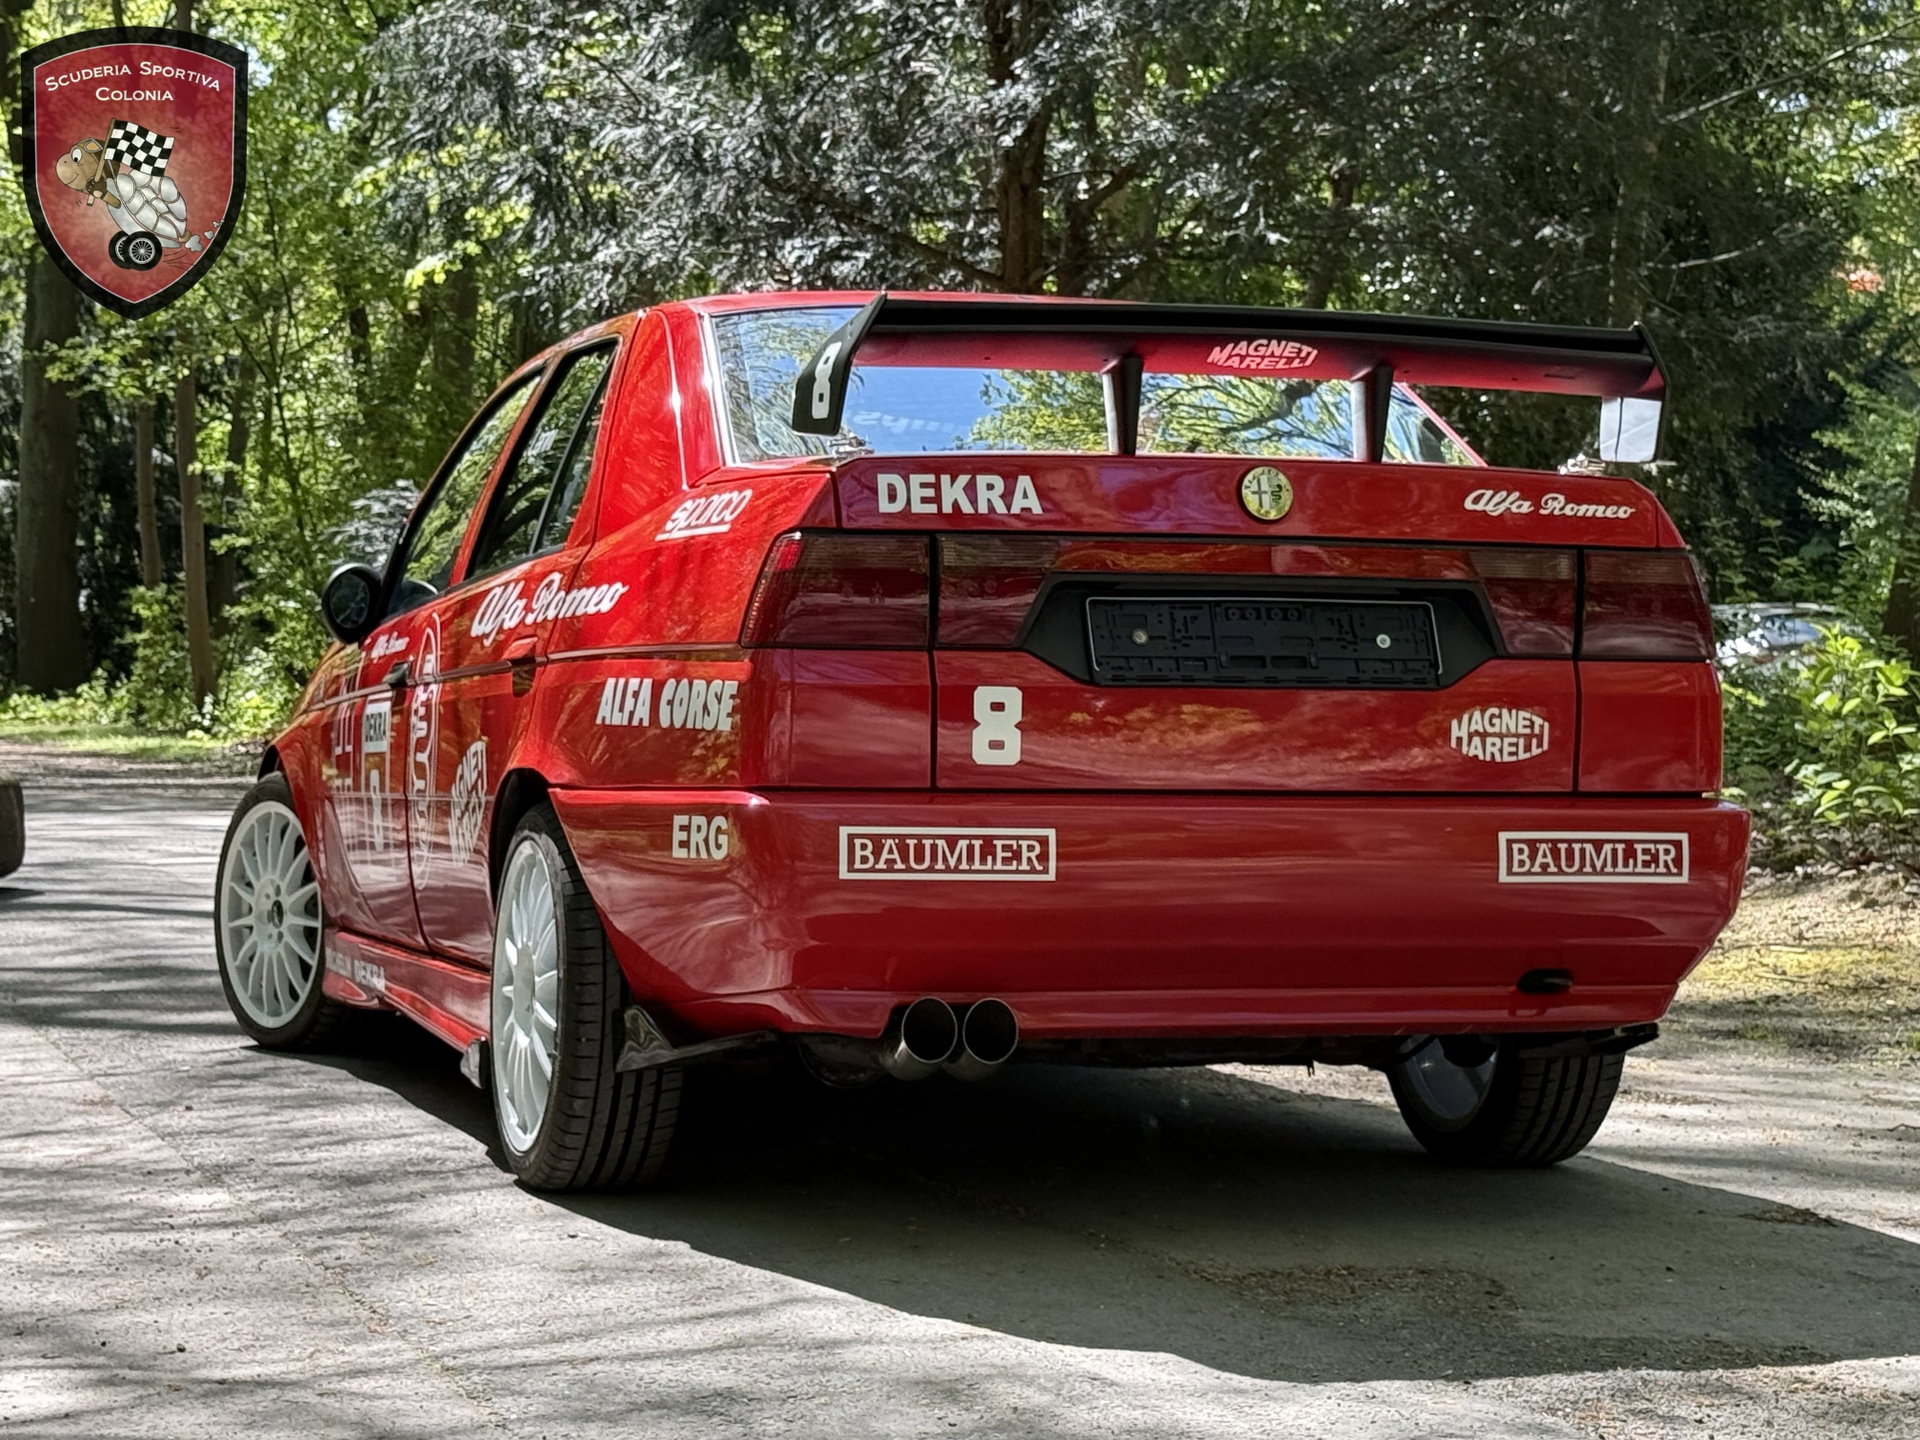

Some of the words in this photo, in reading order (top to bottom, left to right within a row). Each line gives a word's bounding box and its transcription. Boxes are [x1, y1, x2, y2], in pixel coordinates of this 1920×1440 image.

[1207, 339, 1318, 362] MAGNETI
[812, 342, 842, 419] 8
[877, 473, 1043, 515] DEKRA
[1463, 488, 1534, 516] Alfa
[1538, 493, 1636, 519] Romeo
[470, 580, 526, 647] Alfa
[525, 571, 630, 626] Romeo
[595, 677, 653, 728] ALFA
[658, 678, 739, 731] CORSE
[972, 685, 1023, 766] 8
[1451, 706, 1550, 744] MAGNETI
[1451, 727, 1550, 763] MARELLI
[671, 814, 729, 861] ERG
[853, 837, 1044, 872] BÄUMLER
[1511, 842, 1678, 874] BÄUMLER
